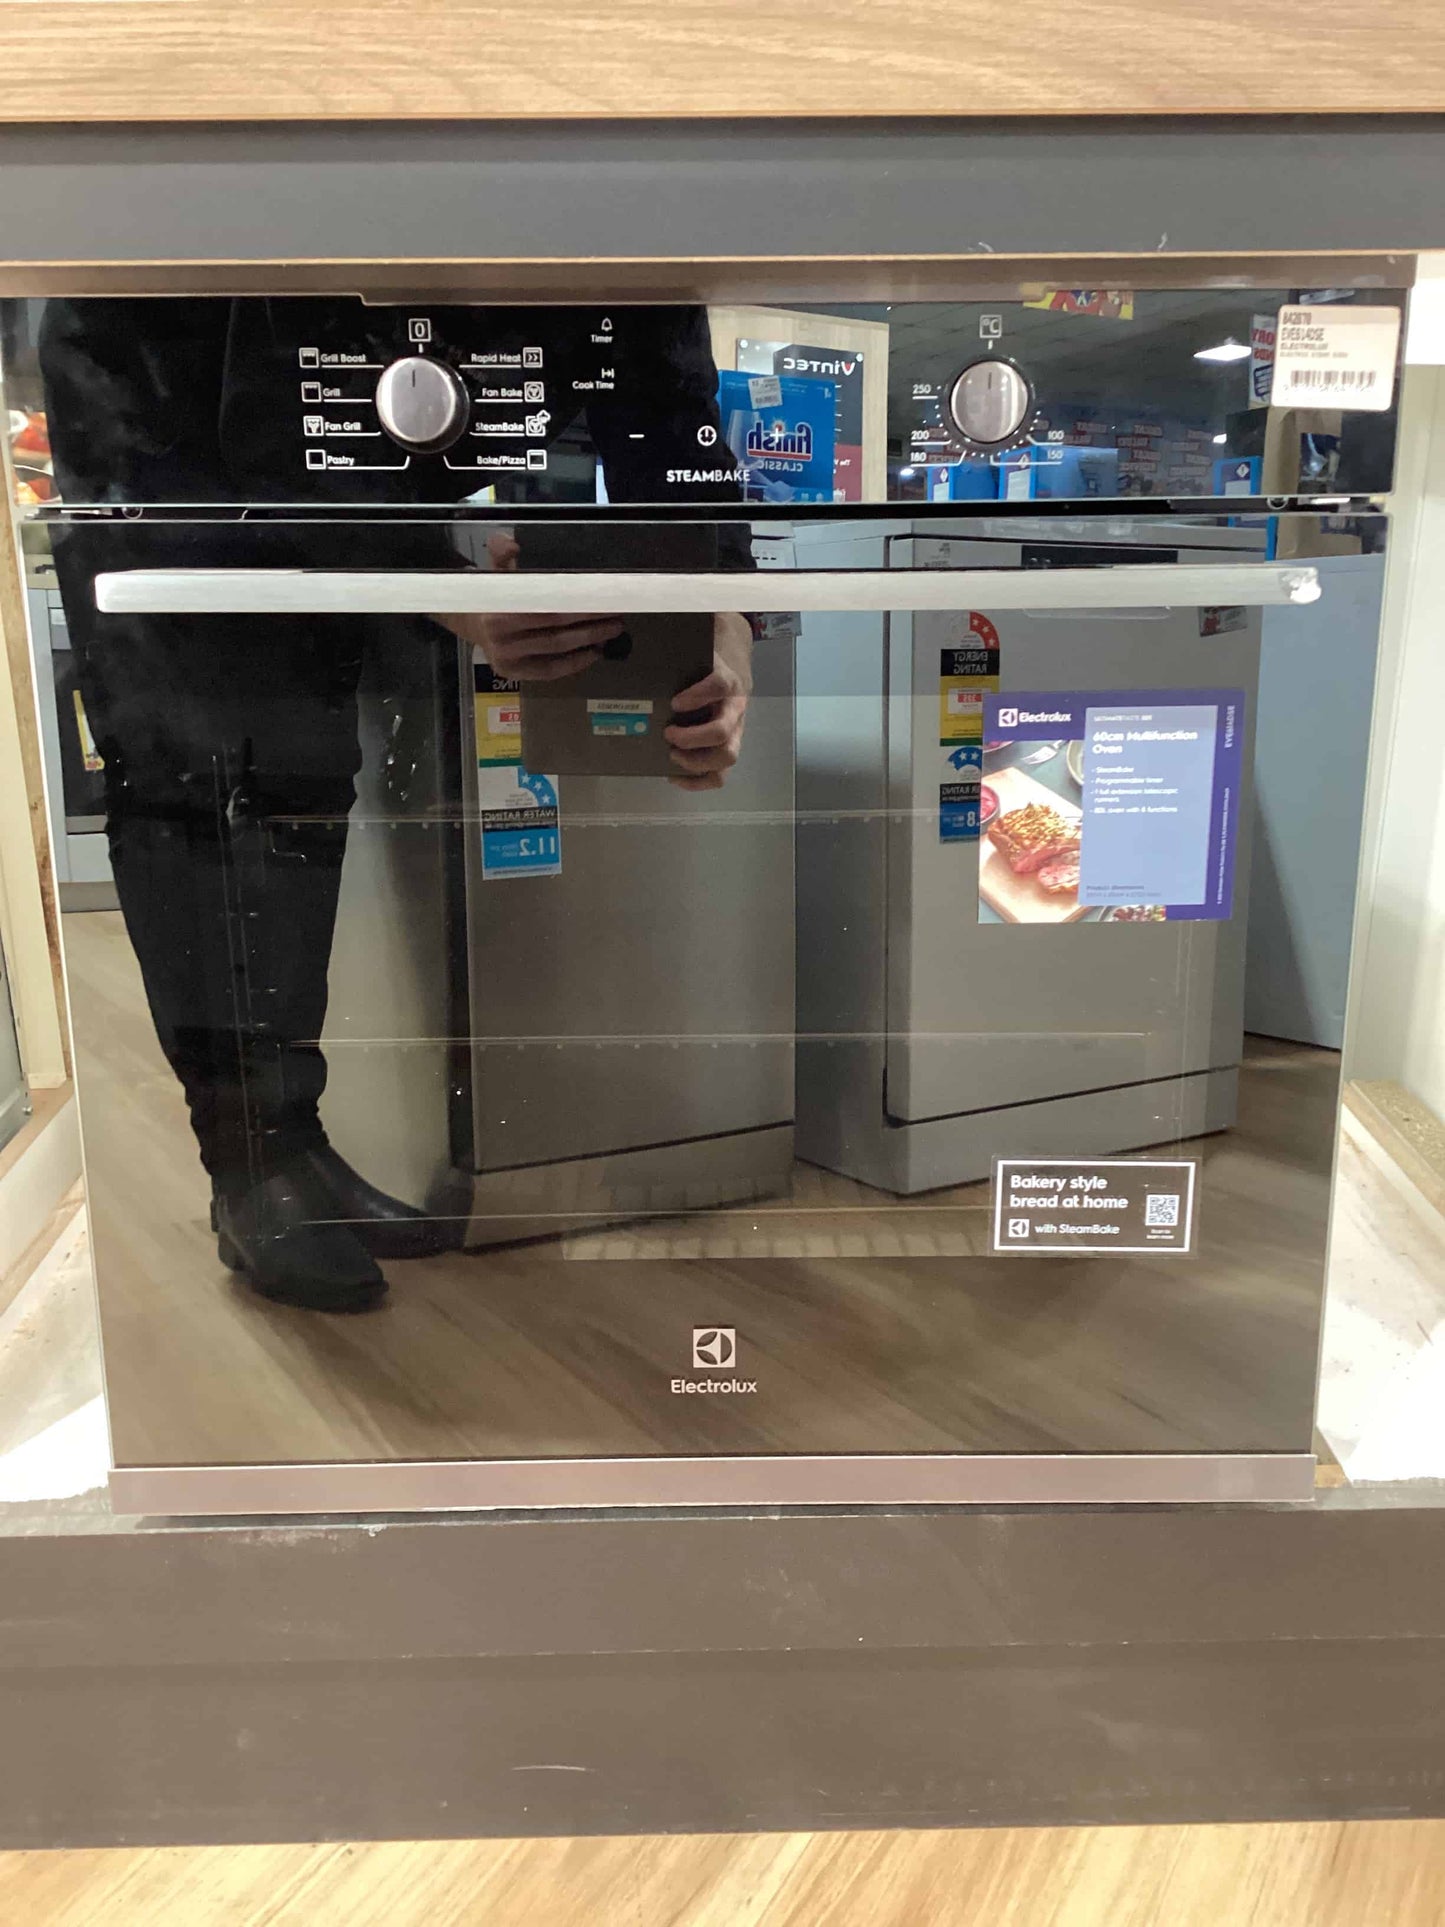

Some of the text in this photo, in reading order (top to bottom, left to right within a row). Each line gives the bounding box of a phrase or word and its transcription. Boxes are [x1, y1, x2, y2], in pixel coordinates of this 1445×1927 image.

[982, 317, 1000, 334] °C
[414, 324, 425, 338] 0
[590, 334, 613, 343] Timer
[320, 354, 366, 363] Grill Boost
[471, 353, 521, 365] Rapid Heat
[572, 381, 614, 390] Cook Time
[913, 384, 931, 394] 250
[322, 387, 341, 397] Grill
[482, 387, 523, 397] Fan Bake
[325, 421, 361, 431] Fan Grill
[475, 422, 524, 432] SteamBake
[911, 430, 929, 440] 200
[1047, 431, 1064, 440] 100
[1047, 450, 1062, 459] 150
[327, 455, 354, 467] Pastry
[477, 455, 526, 466] Bake/Pizza
[666, 469, 751, 483] STEAMBAKE
[1018, 711, 1072, 723] Electrolux
[1092, 730, 1198, 742] 60cm Multifunction
[1091, 744, 1123, 754] Oven
[1010, 1175, 1108, 1192] Bakery style
[1009, 1194, 1129, 1209] bread at home
[1034, 1223, 1121, 1235] with SteamBake
[670, 1378, 758, 1394] Electrolux
